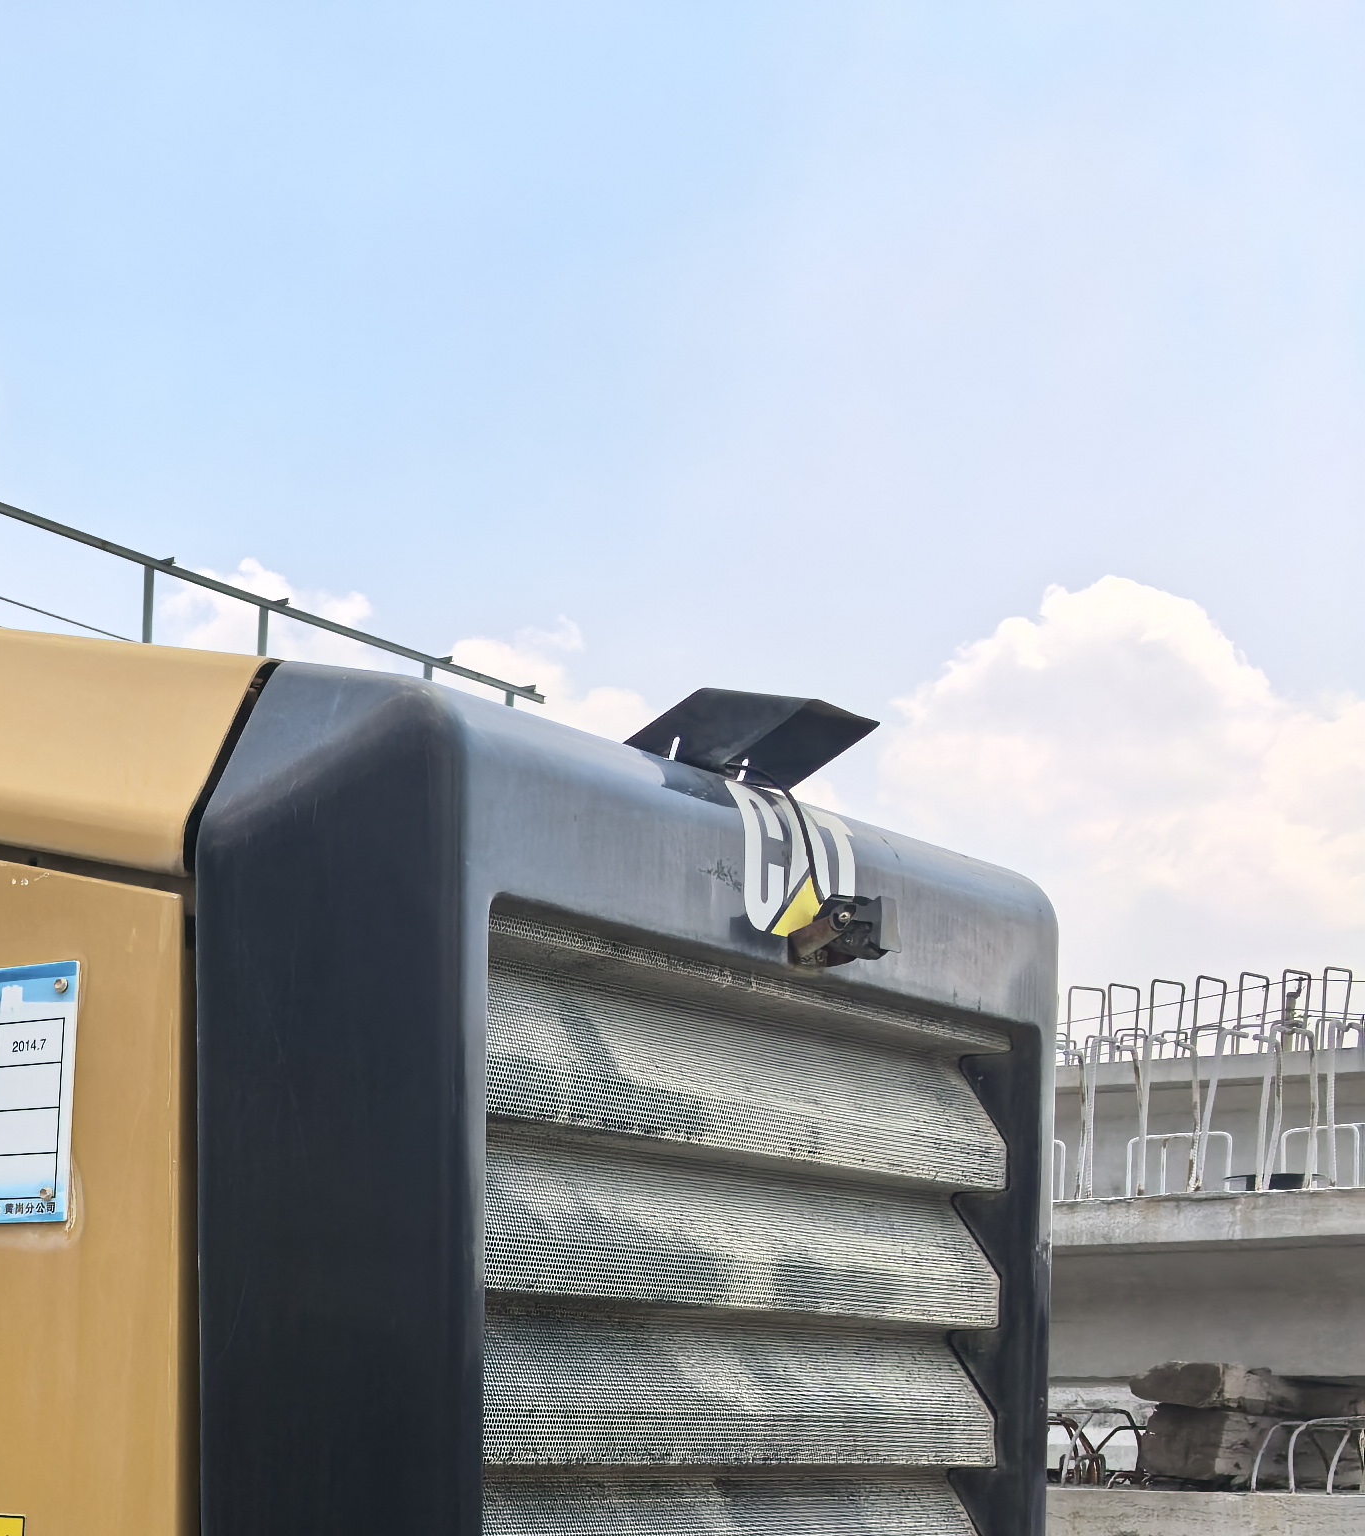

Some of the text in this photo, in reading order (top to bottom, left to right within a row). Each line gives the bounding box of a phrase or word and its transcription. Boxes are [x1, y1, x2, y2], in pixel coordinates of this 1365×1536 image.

[725, 781, 857, 935] CAT
[12, 1039, 47, 1053] 2014.7
[4, 1202, 56, 1215] 黄岗分公司
